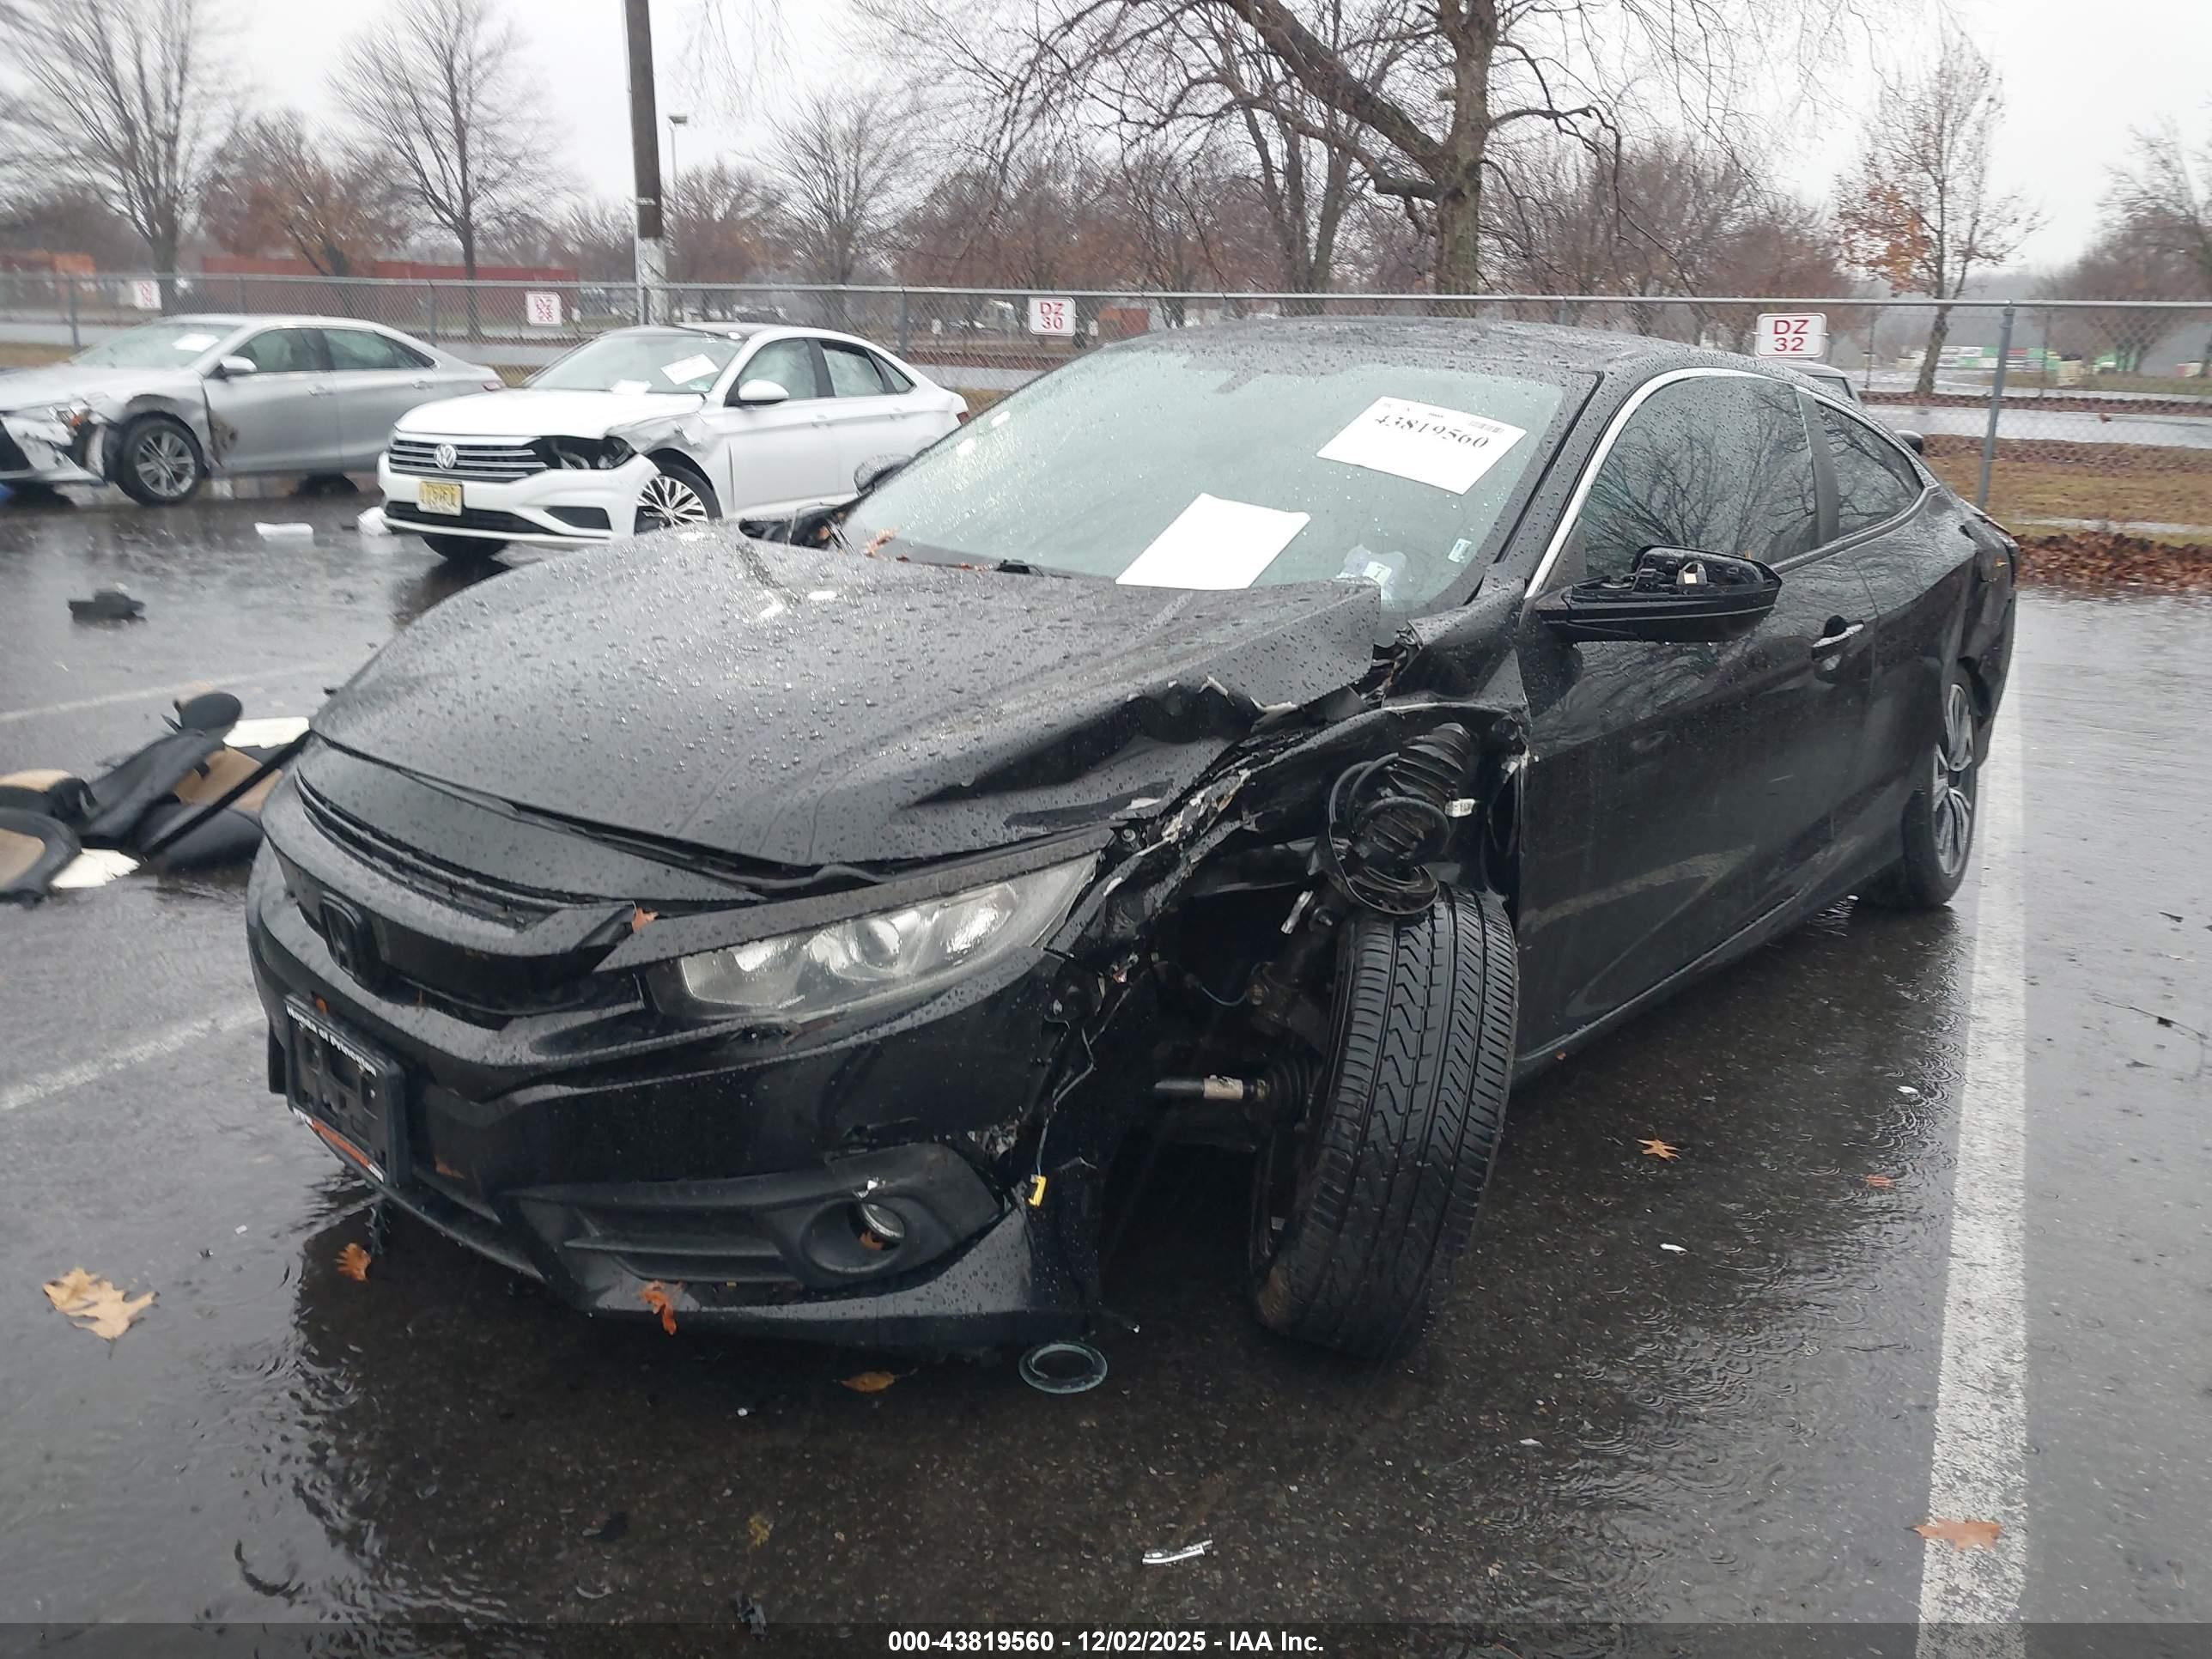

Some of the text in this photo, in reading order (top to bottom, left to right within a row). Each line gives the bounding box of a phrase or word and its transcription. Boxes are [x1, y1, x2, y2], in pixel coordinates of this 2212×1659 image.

[1040, 301, 1065, 316] DZ
[1773, 319, 1809, 335] DZ
[1773, 337, 1805, 352] 32
[1374, 414, 1490, 448] 43819560
